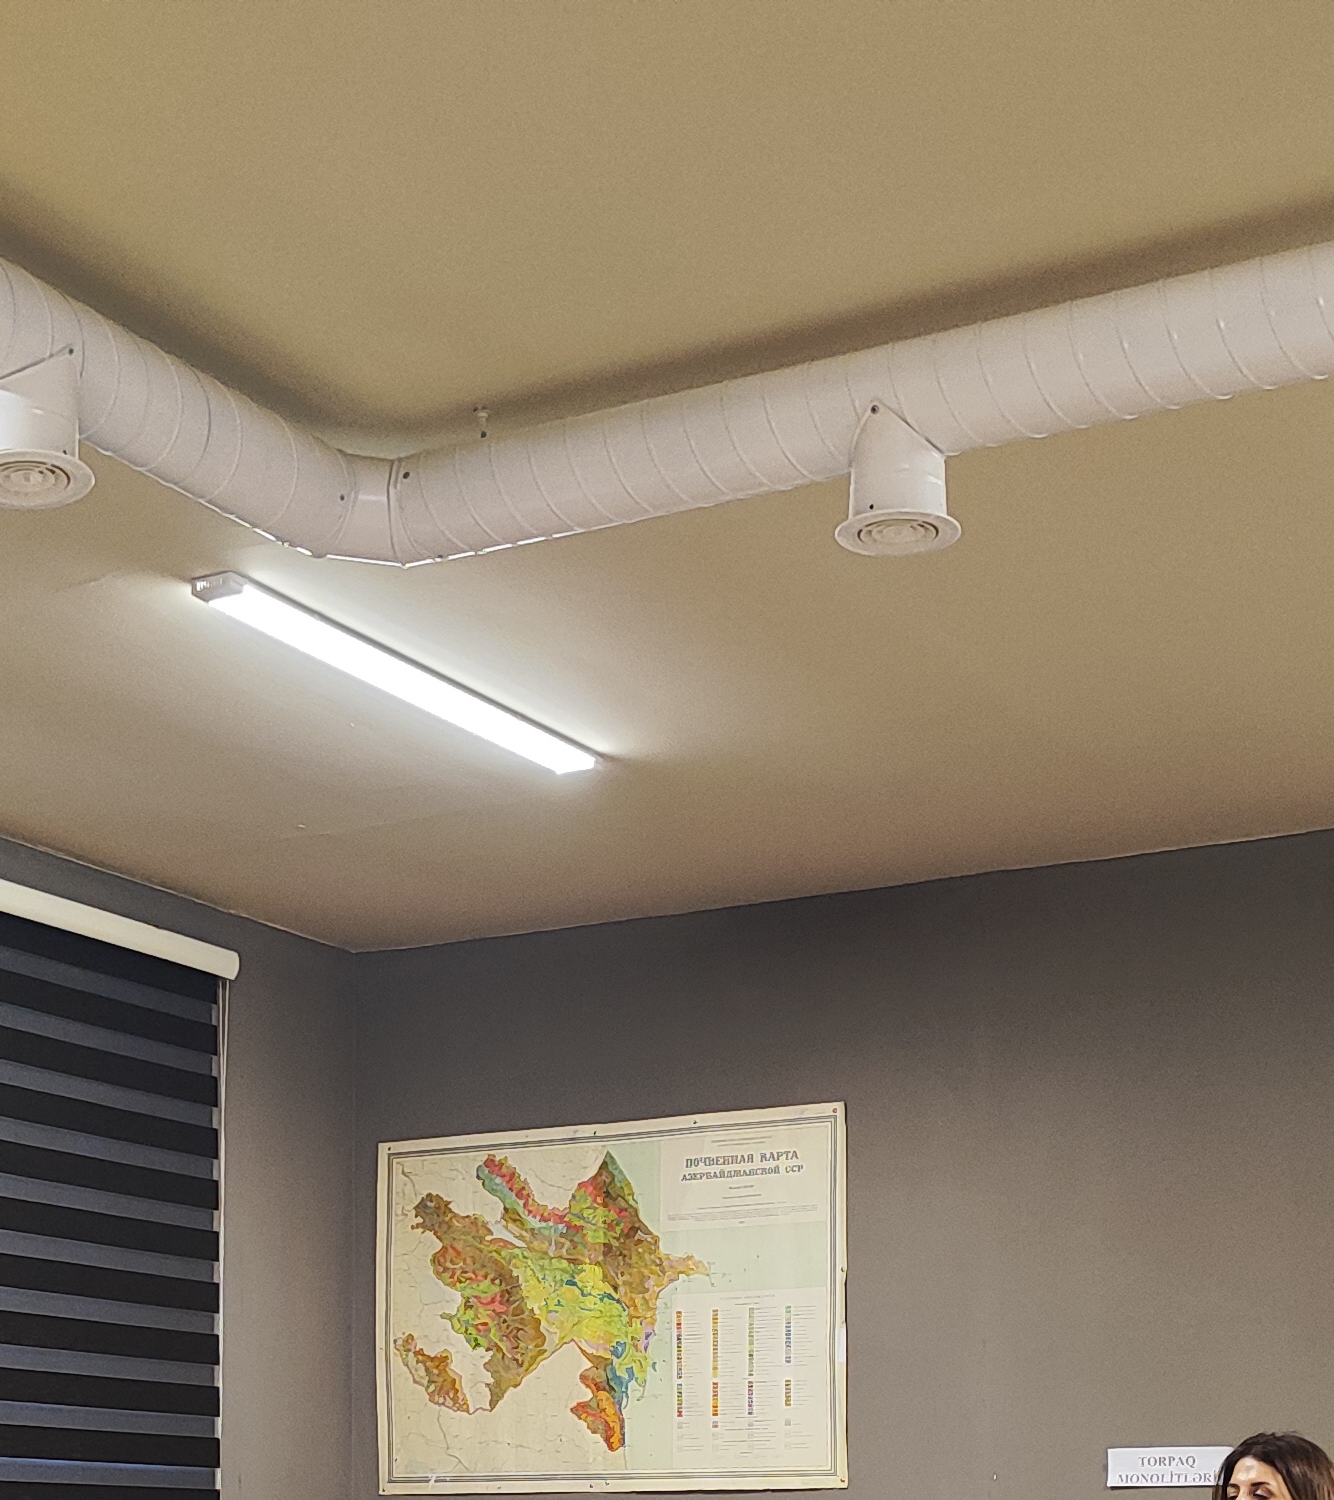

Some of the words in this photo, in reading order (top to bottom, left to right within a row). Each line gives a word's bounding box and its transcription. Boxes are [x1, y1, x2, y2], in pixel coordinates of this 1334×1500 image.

[685, 1153, 754, 1169] ПОЧВЕННАЯ
[760, 1150, 799, 1163] КАРТА
[681, 1165, 780, 1182] АЗЕРБАЙДЖАНСКОЙ
[785, 1164, 804, 1174] ССР
[1138, 1456, 1196, 1468] TORPAQ
